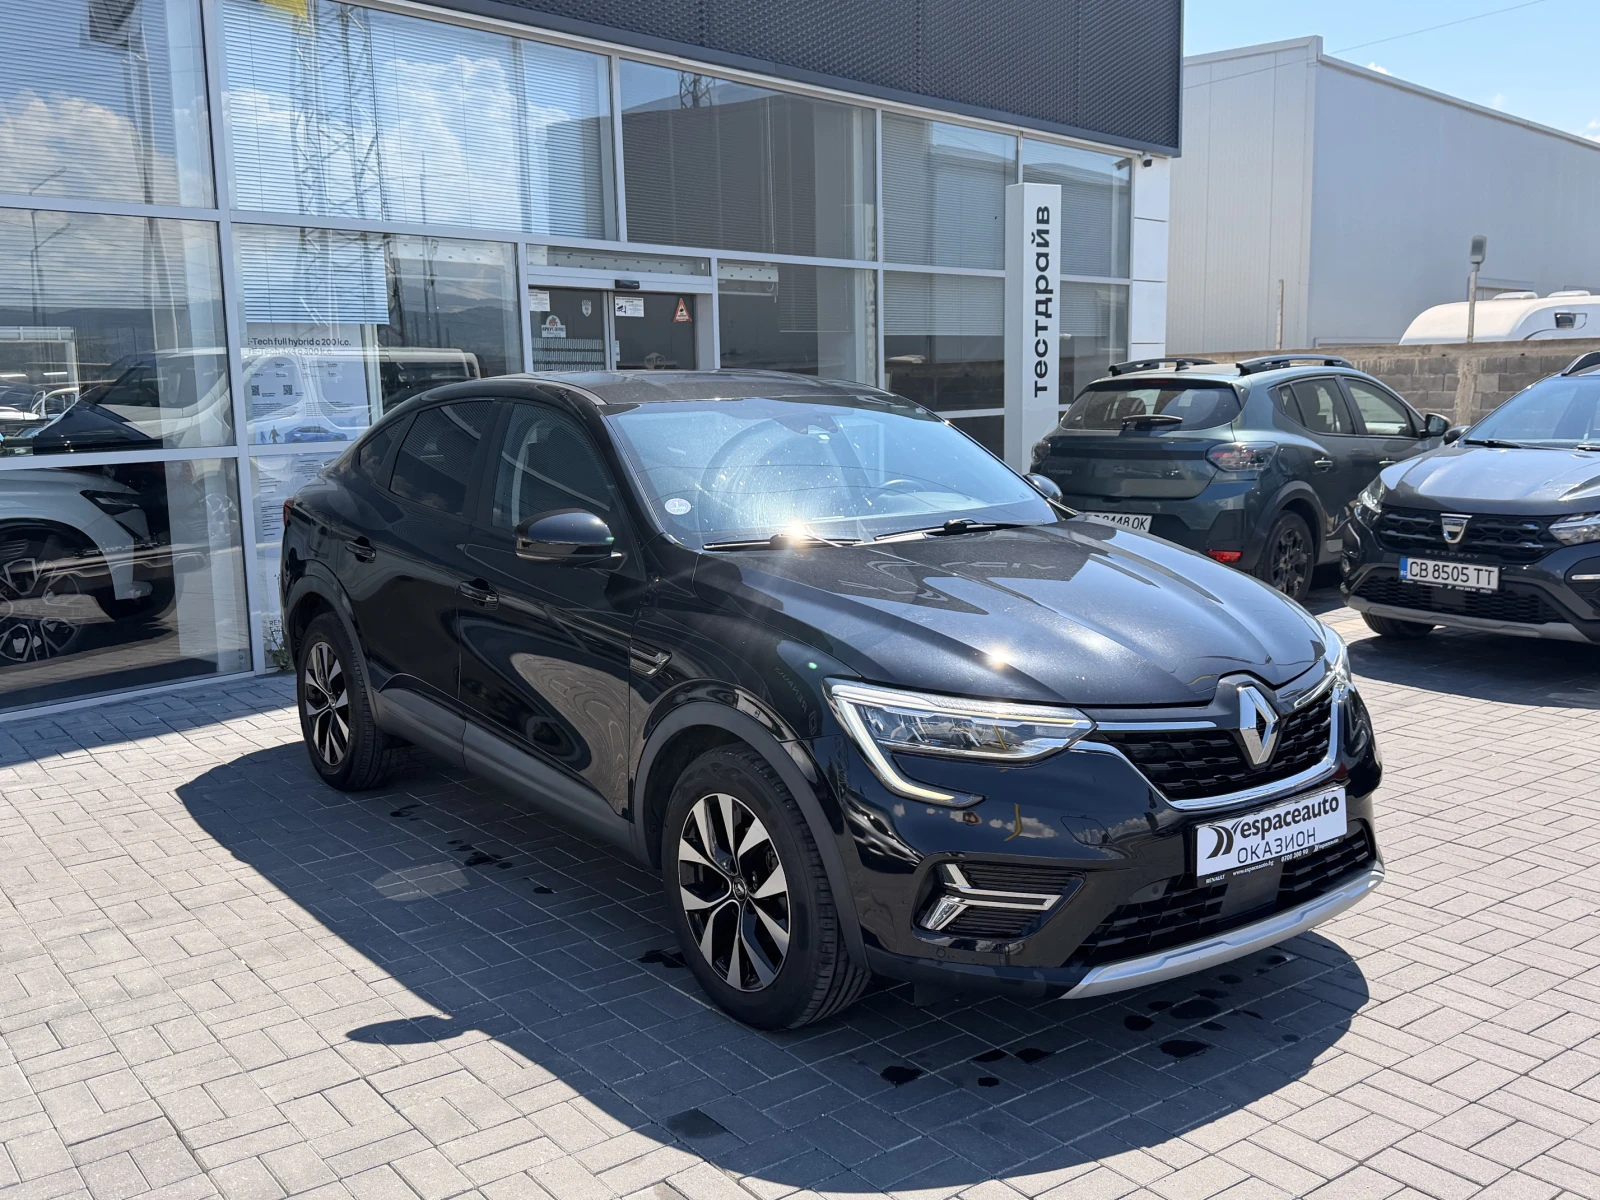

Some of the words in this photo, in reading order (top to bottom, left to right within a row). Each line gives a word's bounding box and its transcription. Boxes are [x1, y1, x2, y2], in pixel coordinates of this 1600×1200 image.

[1031, 205, 1054, 398] тестдрайв
[274, 337, 287, 346] full
[288, 337, 314, 347] hybrid
[321, 338, 336, 346] 200
[1131, 517, 1148, 530] OK
[1425, 549, 1480, 559] STEPWAY
[1410, 561, 1428, 578] CB
[1432, 563, 1470, 583] 8505
[1473, 567, 1495, 586] TT
[1240, 795, 1339, 840] espaceauto
[1237, 827, 1316, 864] ОКАЗИОН
[1205, 874, 1225, 884] RENAULT
